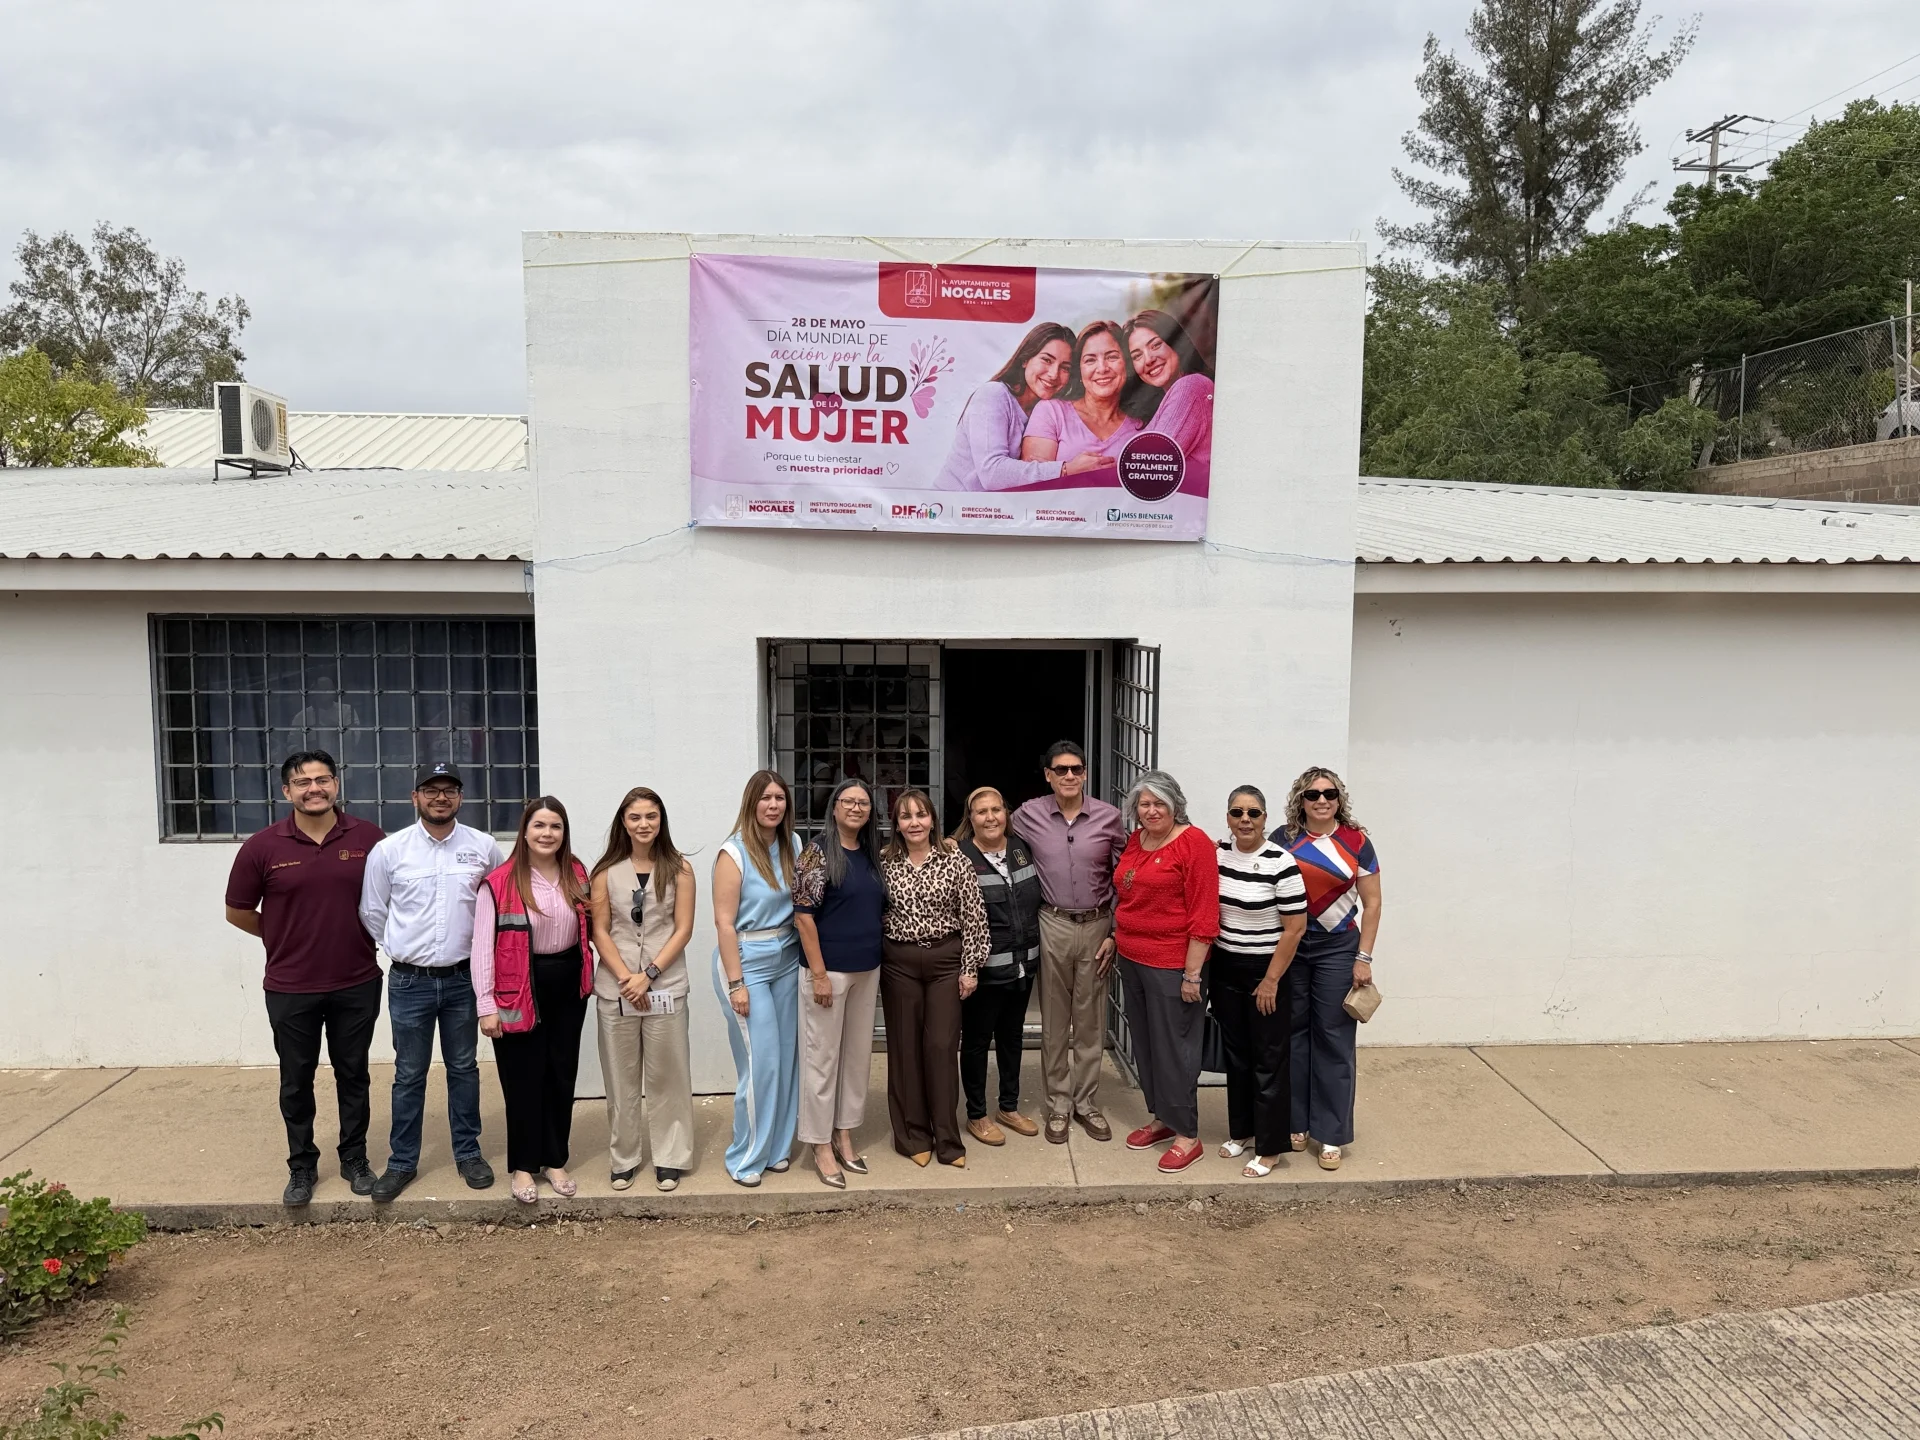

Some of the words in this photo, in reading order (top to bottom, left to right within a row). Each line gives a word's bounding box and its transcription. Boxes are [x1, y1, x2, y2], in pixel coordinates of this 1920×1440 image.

[941, 286, 1011, 301] NOGALES
[791, 317, 807, 328] 28
[810, 318, 826, 329] DE
[830, 319, 866, 330] MAYO
[767, 327, 792, 342] DÍA
[796, 331, 865, 345] MUNDIAL
[869, 333, 888, 346] DE
[770, 347, 828, 361] acción
[828, 350, 862, 372] por
[866, 342, 885, 364] la
[745, 361, 908, 403] SALUD
[815, 400, 827, 409] DE
[828, 401, 840, 409] LA
[745, 404, 910, 445] MUJER
[763, 452, 802, 463] ¡Porque
[804, 454, 815, 462] tu
[817, 453, 862, 464] bienestar
[1131, 453, 1173, 461] SERVICIOS
[789, 464, 830, 474] nuestra
[833, 466, 884, 476] prioridad!
[1125, 462, 1178, 471] TOTALMENTE
[1128, 473, 1174, 481] GRATUITOS
[748, 505, 795, 513] NOGALES
[891, 504, 917, 516] DIF
[1138, 513, 1174, 521] BIENESTAR
